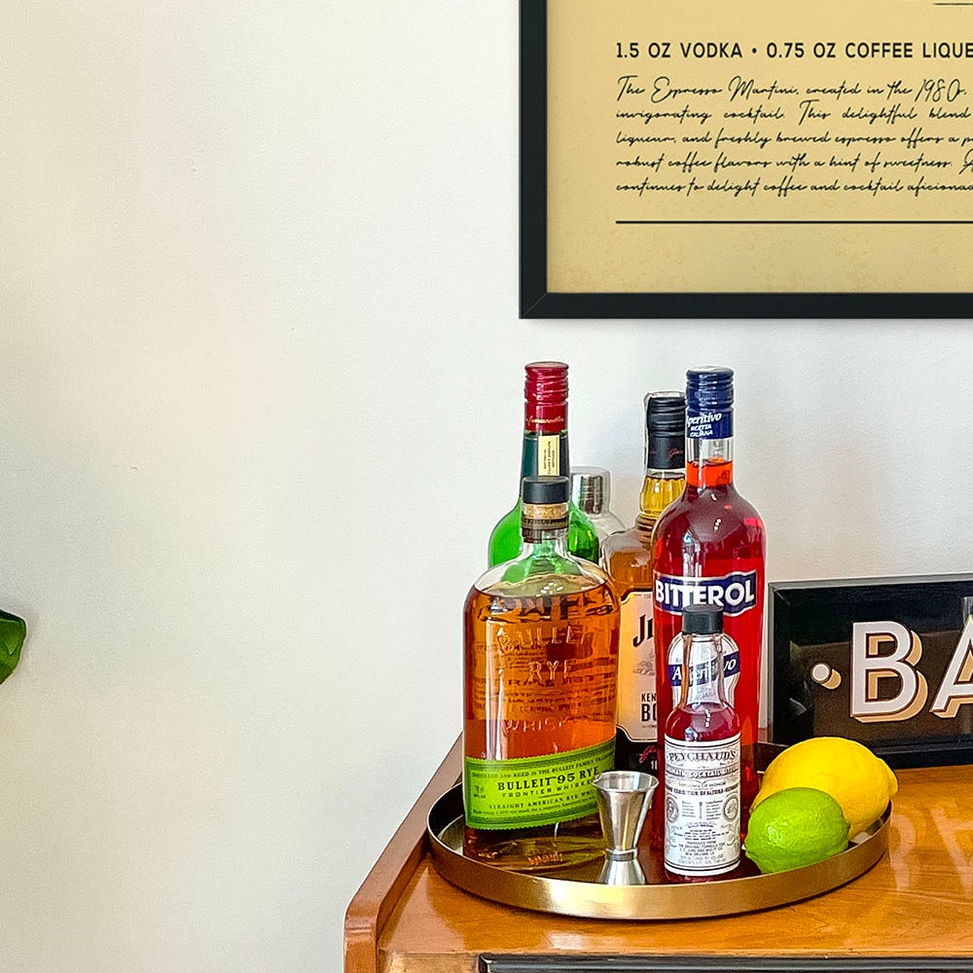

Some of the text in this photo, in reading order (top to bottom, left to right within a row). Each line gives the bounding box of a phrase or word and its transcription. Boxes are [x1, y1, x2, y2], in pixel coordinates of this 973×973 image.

[616, 42, 640, 59] 1.5
[648, 42, 671, 59] OZ
[679, 42, 743, 59] VODKA
[766, 42, 805, 59] 0.75
[813, 42, 837, 59] OZ
[845, 42, 913, 59] COFFEE
[616, 74, 646, 102] The
[650, 75, 723, 104] Espresso
[805, 80, 862, 101] created
[866, 86, 885, 95] in
[886, 79, 913, 100] the
[615, 104, 713, 125] invigorating
[798, 98, 832, 126] This
[841, 103, 918, 125] delightful
[928, 106, 972, 120] blend
[681, 131, 713, 143] and
[714, 127, 772, 150] freshly
[775, 131, 832, 143] brewed
[834, 136, 897, 147] espresso
[900, 127, 945, 150] offers
[947, 135, 961, 143] a
[615, 152, 665, 173] robust
[667, 150, 713, 174] coffee
[713, 151, 773, 174] flavors
[775, 152, 811, 173] with
[828, 152, 862, 173] hint
[864, 151, 881, 174] of
[615, 176, 687, 197] continues
[686, 176, 705, 197] to
[706, 176, 761, 198] delight
[763, 175, 808, 198] coffee
[810, 179, 841, 191] and
[843, 176, 904, 197] cocktail
[655, 579, 755, 608] BITTEROL
[497, 766, 599, 791] BULLEIT 95 RYE
[502, 780, 593, 798] FRONTIER WHISKE
